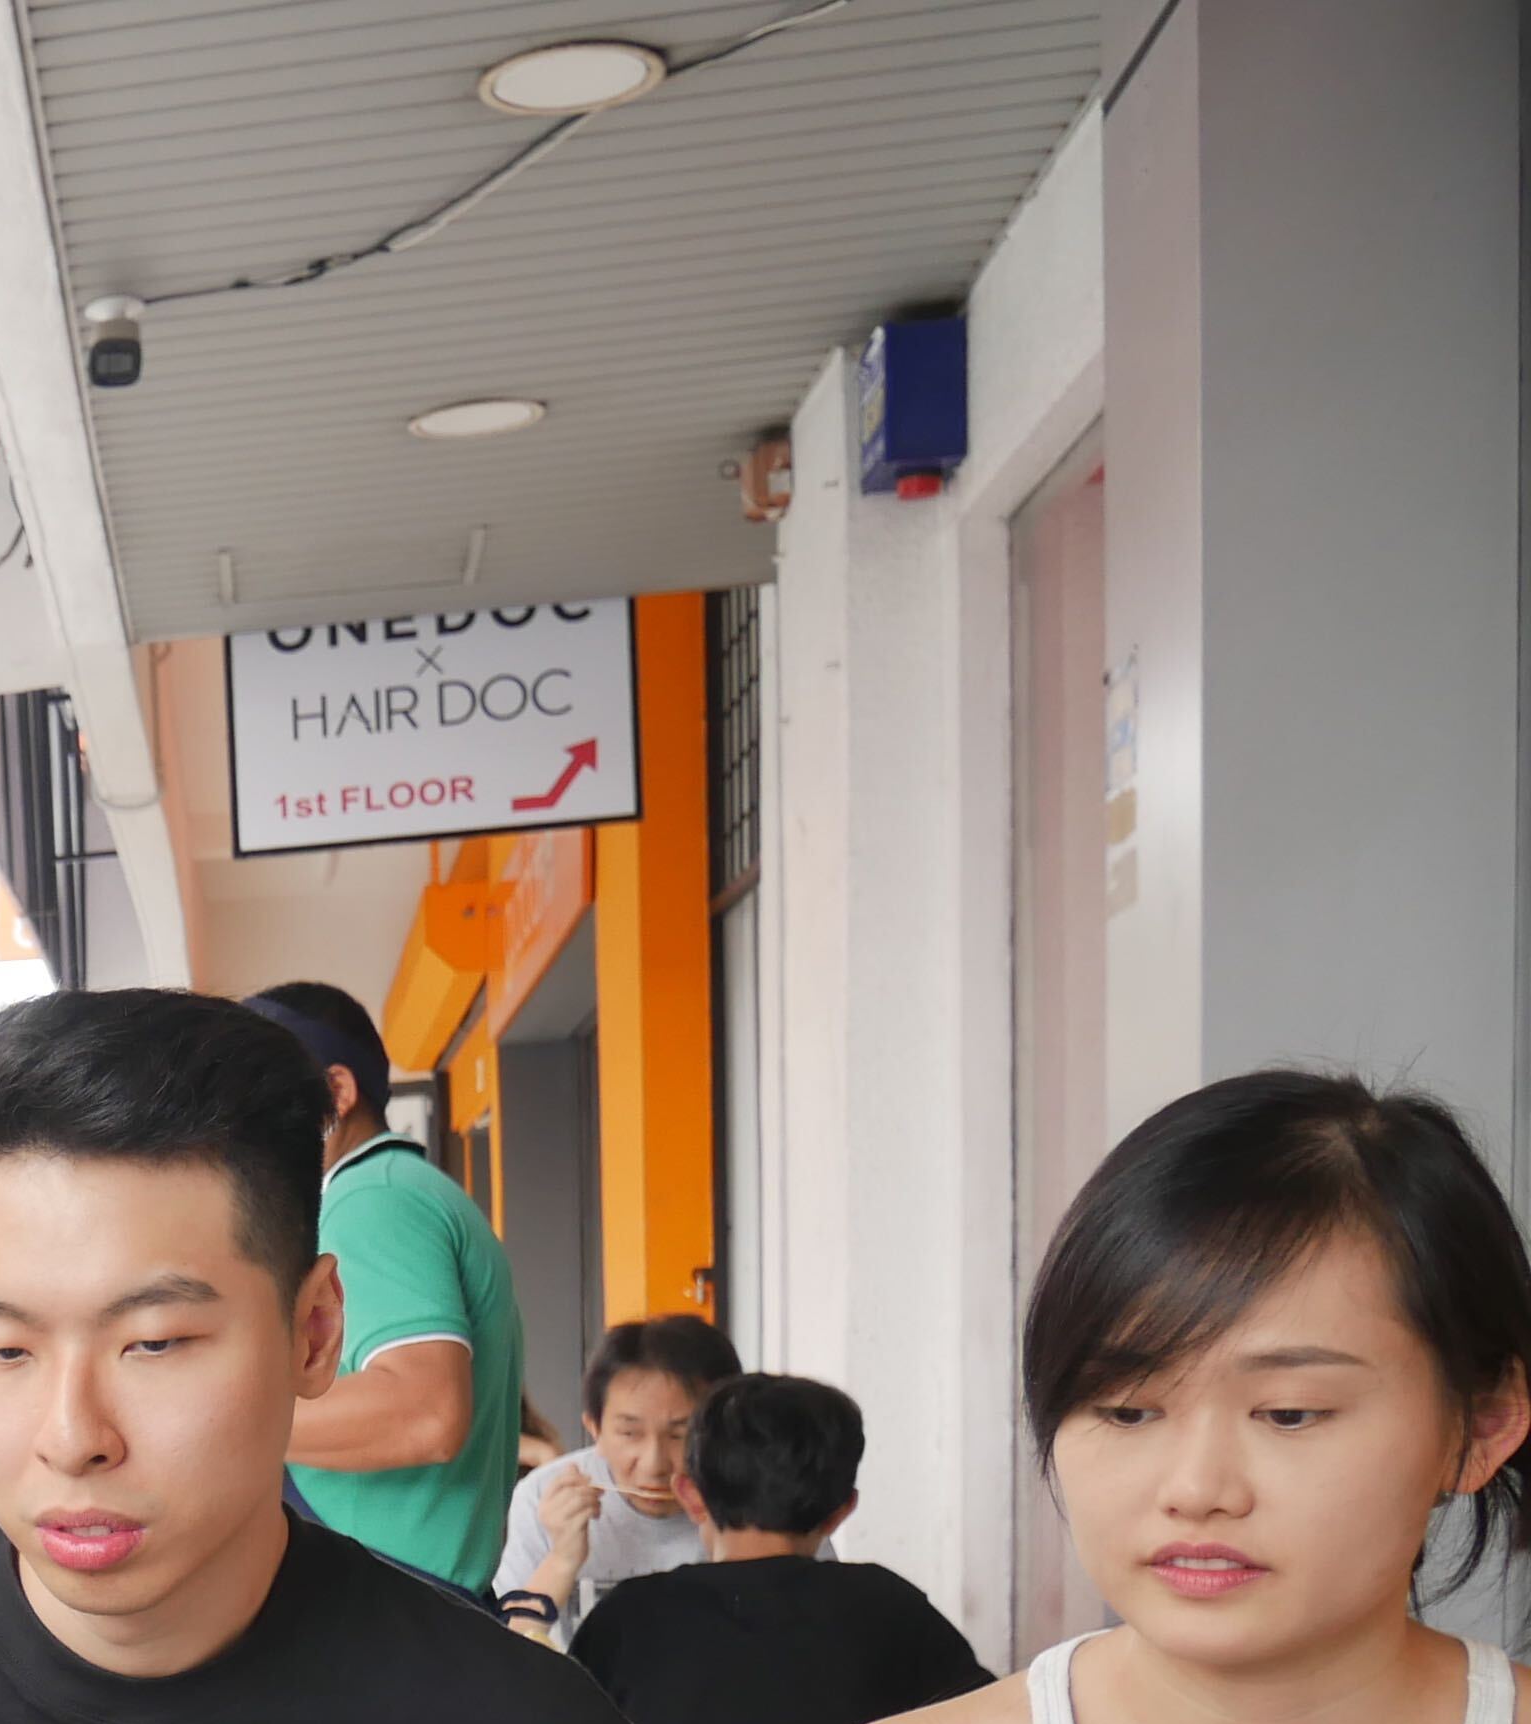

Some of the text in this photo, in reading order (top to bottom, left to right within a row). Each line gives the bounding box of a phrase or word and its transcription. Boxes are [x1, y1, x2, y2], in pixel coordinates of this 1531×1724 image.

[292, 668, 573, 740] HAIR DOC
[274, 775, 476, 820] 1st FLOOR
